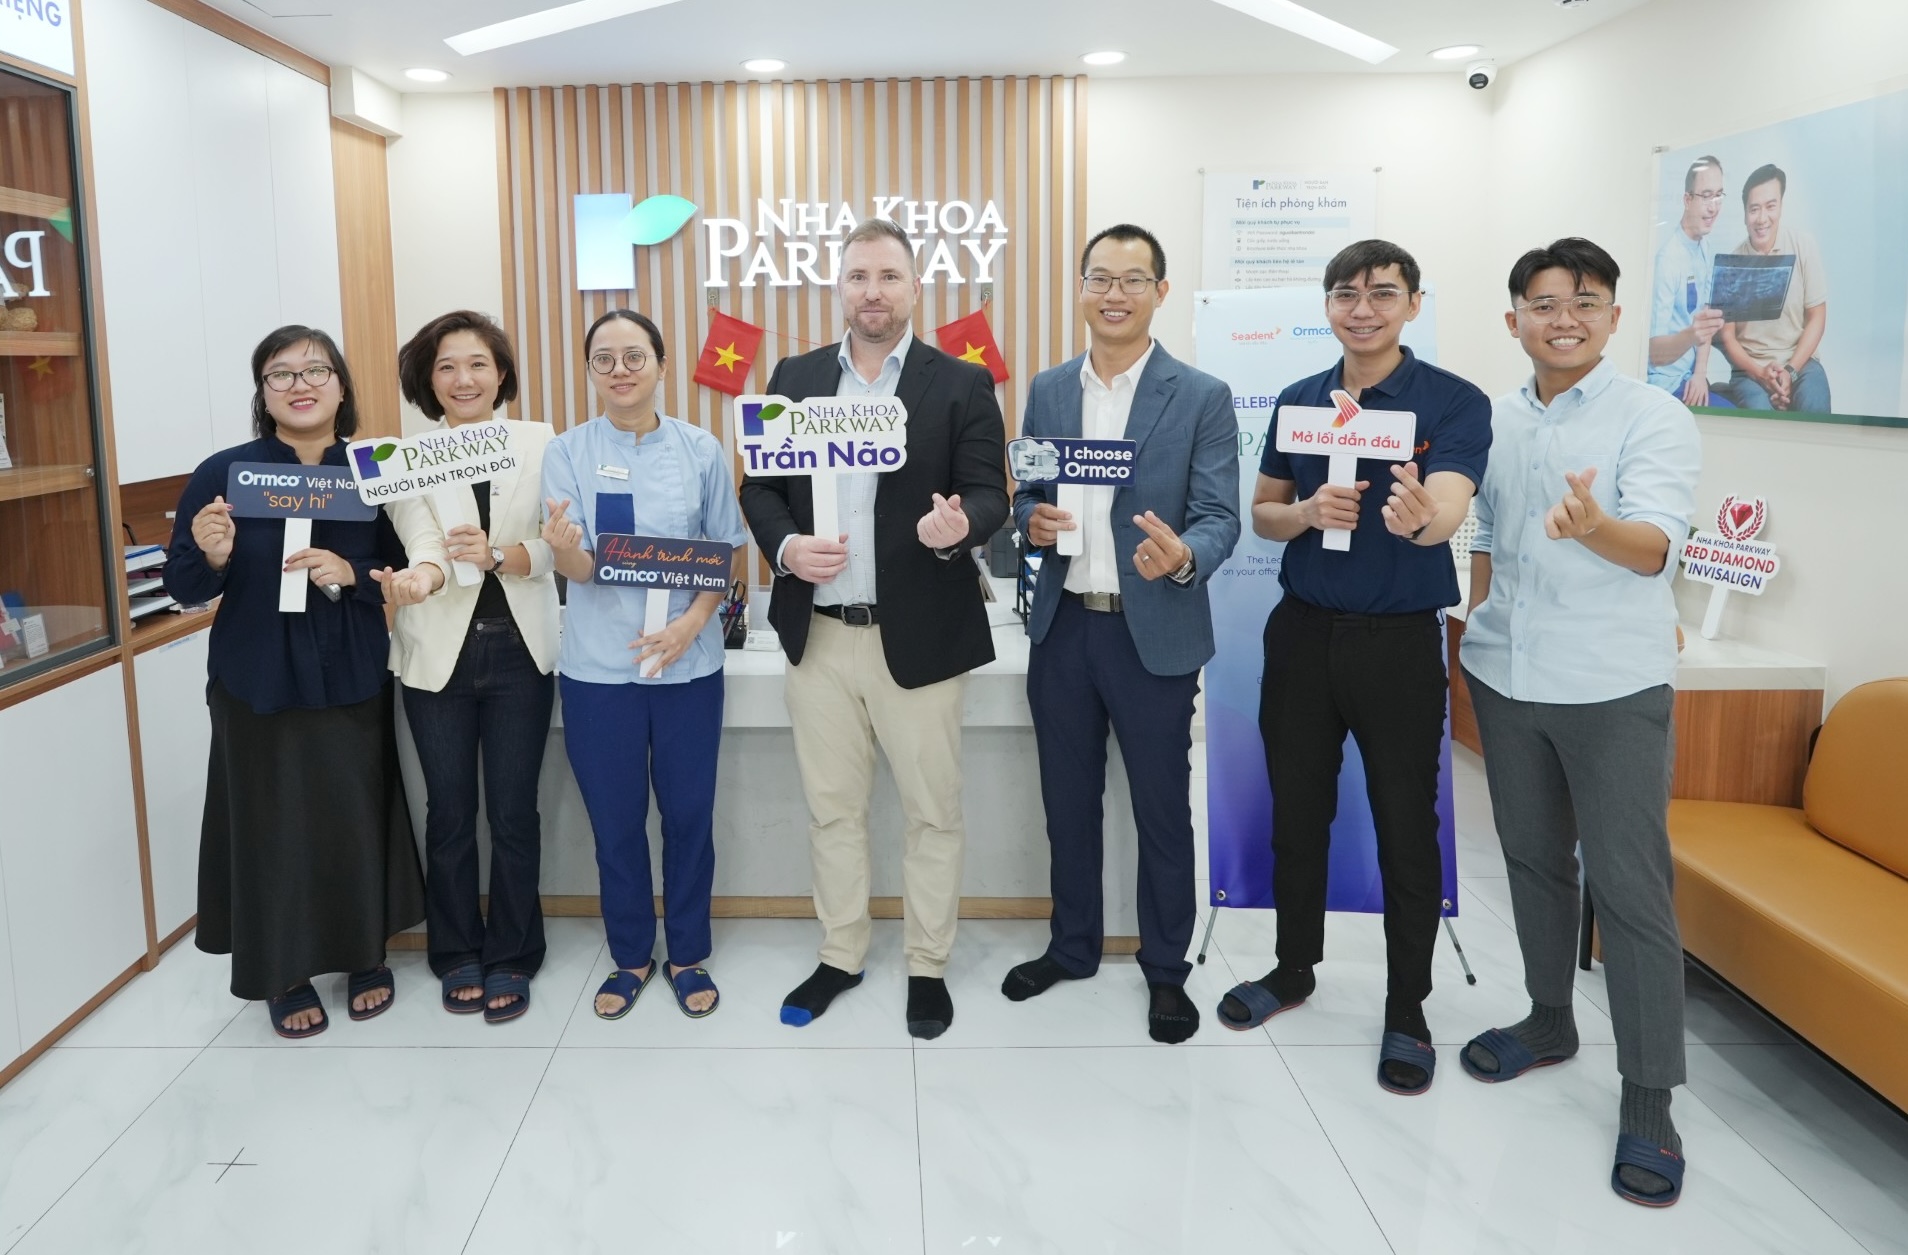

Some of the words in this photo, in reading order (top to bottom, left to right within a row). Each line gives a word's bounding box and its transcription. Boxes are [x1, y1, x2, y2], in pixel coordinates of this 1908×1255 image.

[1235, 198, 1258, 211] Tiện
[1261, 197, 1276, 208] ích
[1279, 197, 1315, 211] phòng
[1318, 196, 1347, 208] khám
[755, 198, 858, 236] NHA
[872, 196, 1008, 235] KHOA
[702, 218, 1008, 287] PARAY
[1231, 331, 1275, 341] Seadent
[1292, 326, 1332, 336] Ormco
[808, 405, 846, 419] NHA
[851, 403, 899, 417] KHOA
[788, 411, 900, 435] PARKWAY
[419, 436, 457, 452] NHA
[460, 424, 510, 444] KHOA
[1292, 430, 1314, 443] Mở
[1317, 431, 1334, 445] lối
[1337, 432, 1367, 447] dẫn
[401, 435, 510, 472] PARKWAY
[743, 437, 817, 470] Trần
[827, 440, 901, 468] Não
[1065, 445, 1070, 459] I
[1074, 446, 1133, 461] choose
[306, 476, 333, 491] Việt
[366, 478, 415, 499] NGƯỜI
[417, 472, 447, 488] BẠN
[449, 463, 487, 480] TRỌN
[490, 456, 516, 472] ĐỜI
[263, 491, 304, 512] "say
[309, 493, 333, 509] hi"
[604, 537, 654, 562] Hành
[657, 547, 693, 562] trình
[695, 553, 725, 566] mới
[1696, 536, 1712, 546] NHA
[1713, 539, 1735, 549] KHOA
[1735, 543, 1771, 556] PARKWAY
[1246, 555, 1264, 564] The
[1684, 545, 1708, 560] RED
[1710, 550, 1775, 574] DIAMOND
[661, 571, 690, 588] Việt
[692, 573, 726, 588] Nam
[1236, 569, 1256, 577] your
[1688, 562, 1762, 589] INVISALIGN
